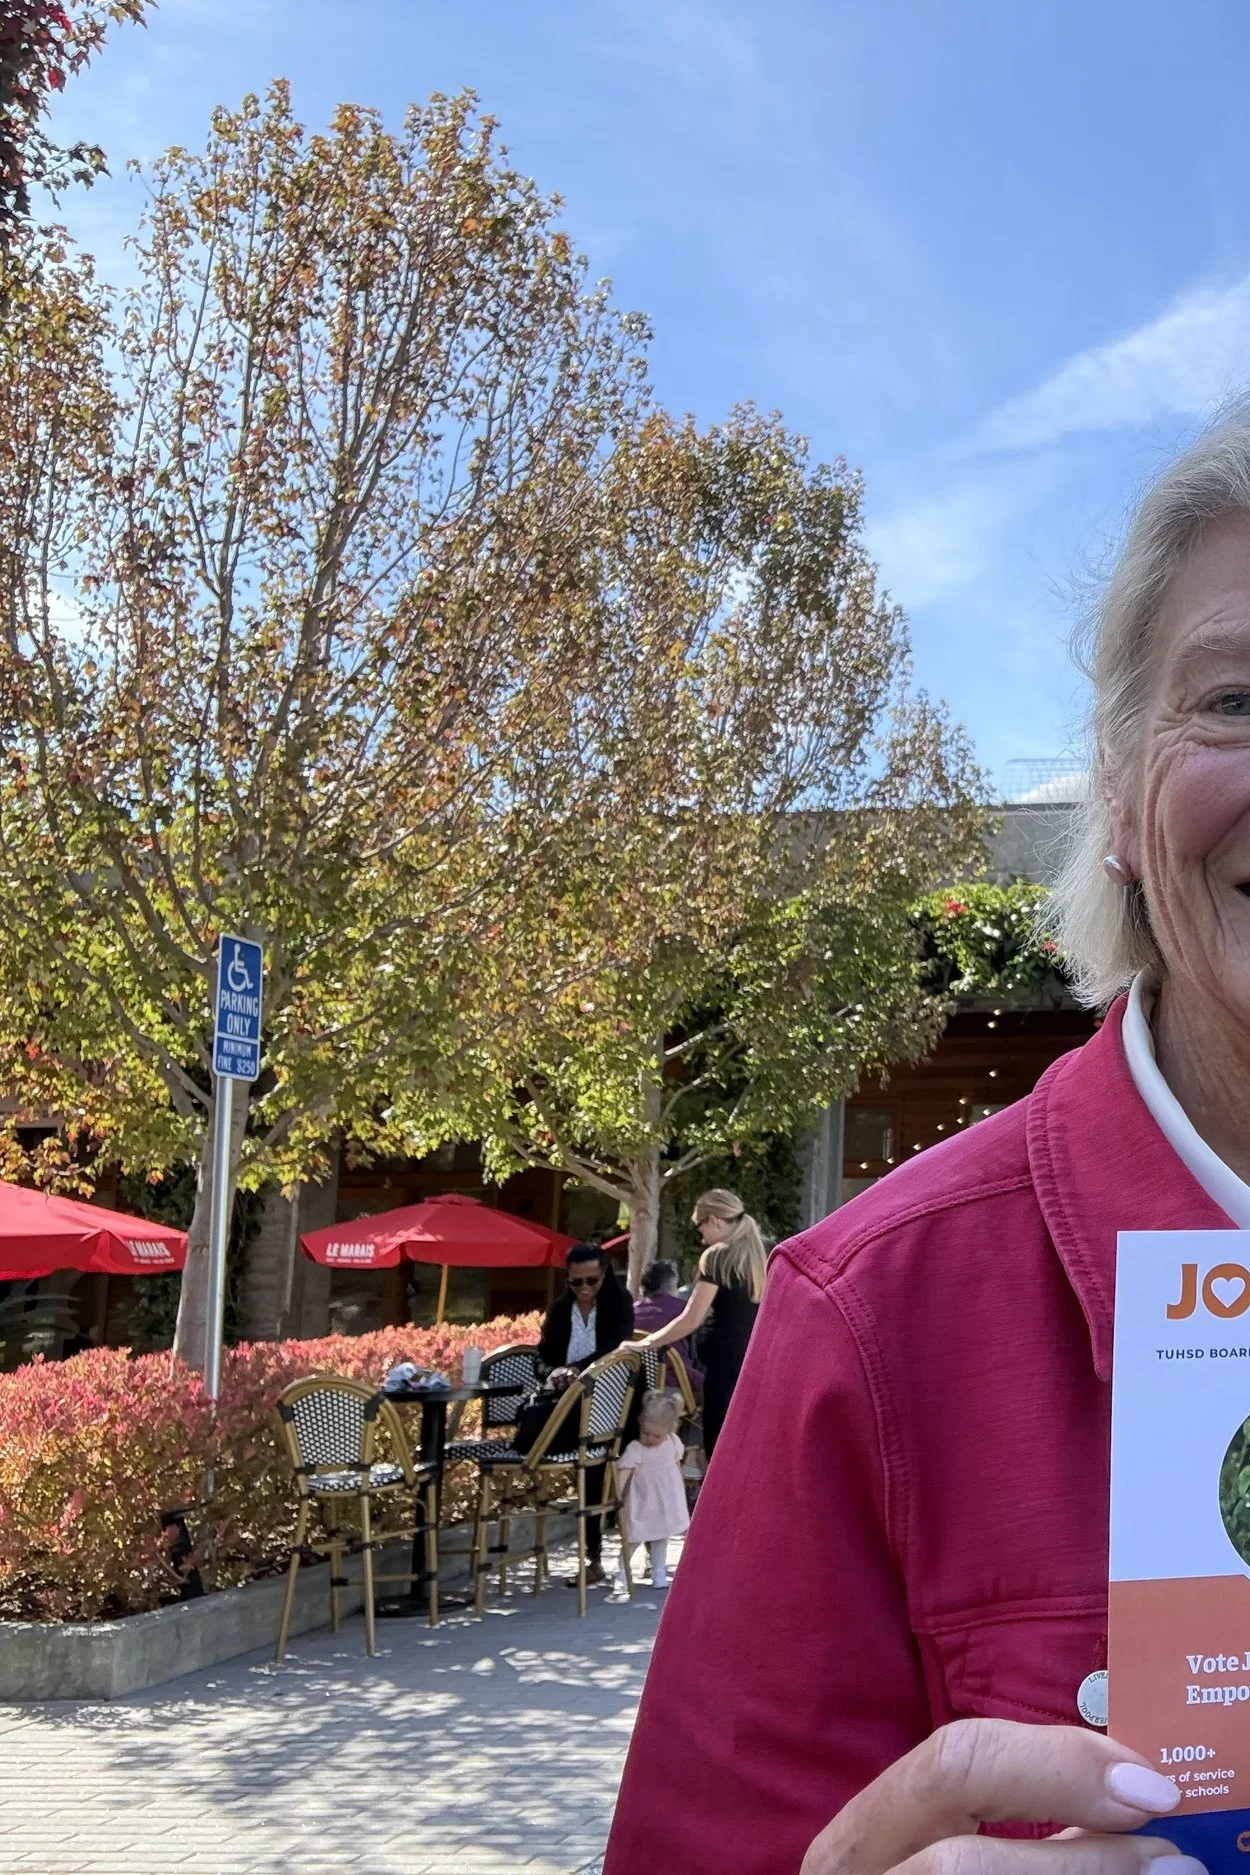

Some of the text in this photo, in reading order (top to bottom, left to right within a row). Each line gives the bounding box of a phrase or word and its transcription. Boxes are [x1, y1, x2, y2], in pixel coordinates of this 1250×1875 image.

[220, 989, 259, 1018] PARKING
[226, 1012, 251, 1037] ONLY
[223, 1040, 252, 1058] MINIMUM
[217, 1055, 256, 1076] FINE $250
[326, 1242, 375, 1258] LE MARAIS
[1156, 1349, 1204, 1360] TUHSD
[1186, 1653, 1239, 1675] Vote
[1160, 1744, 1216, 1765] 1,000+
[1179, 1771, 1191, 1783] of
[1193, 1768, 1236, 1782] service
[1185, 1784, 1230, 1798] schools
